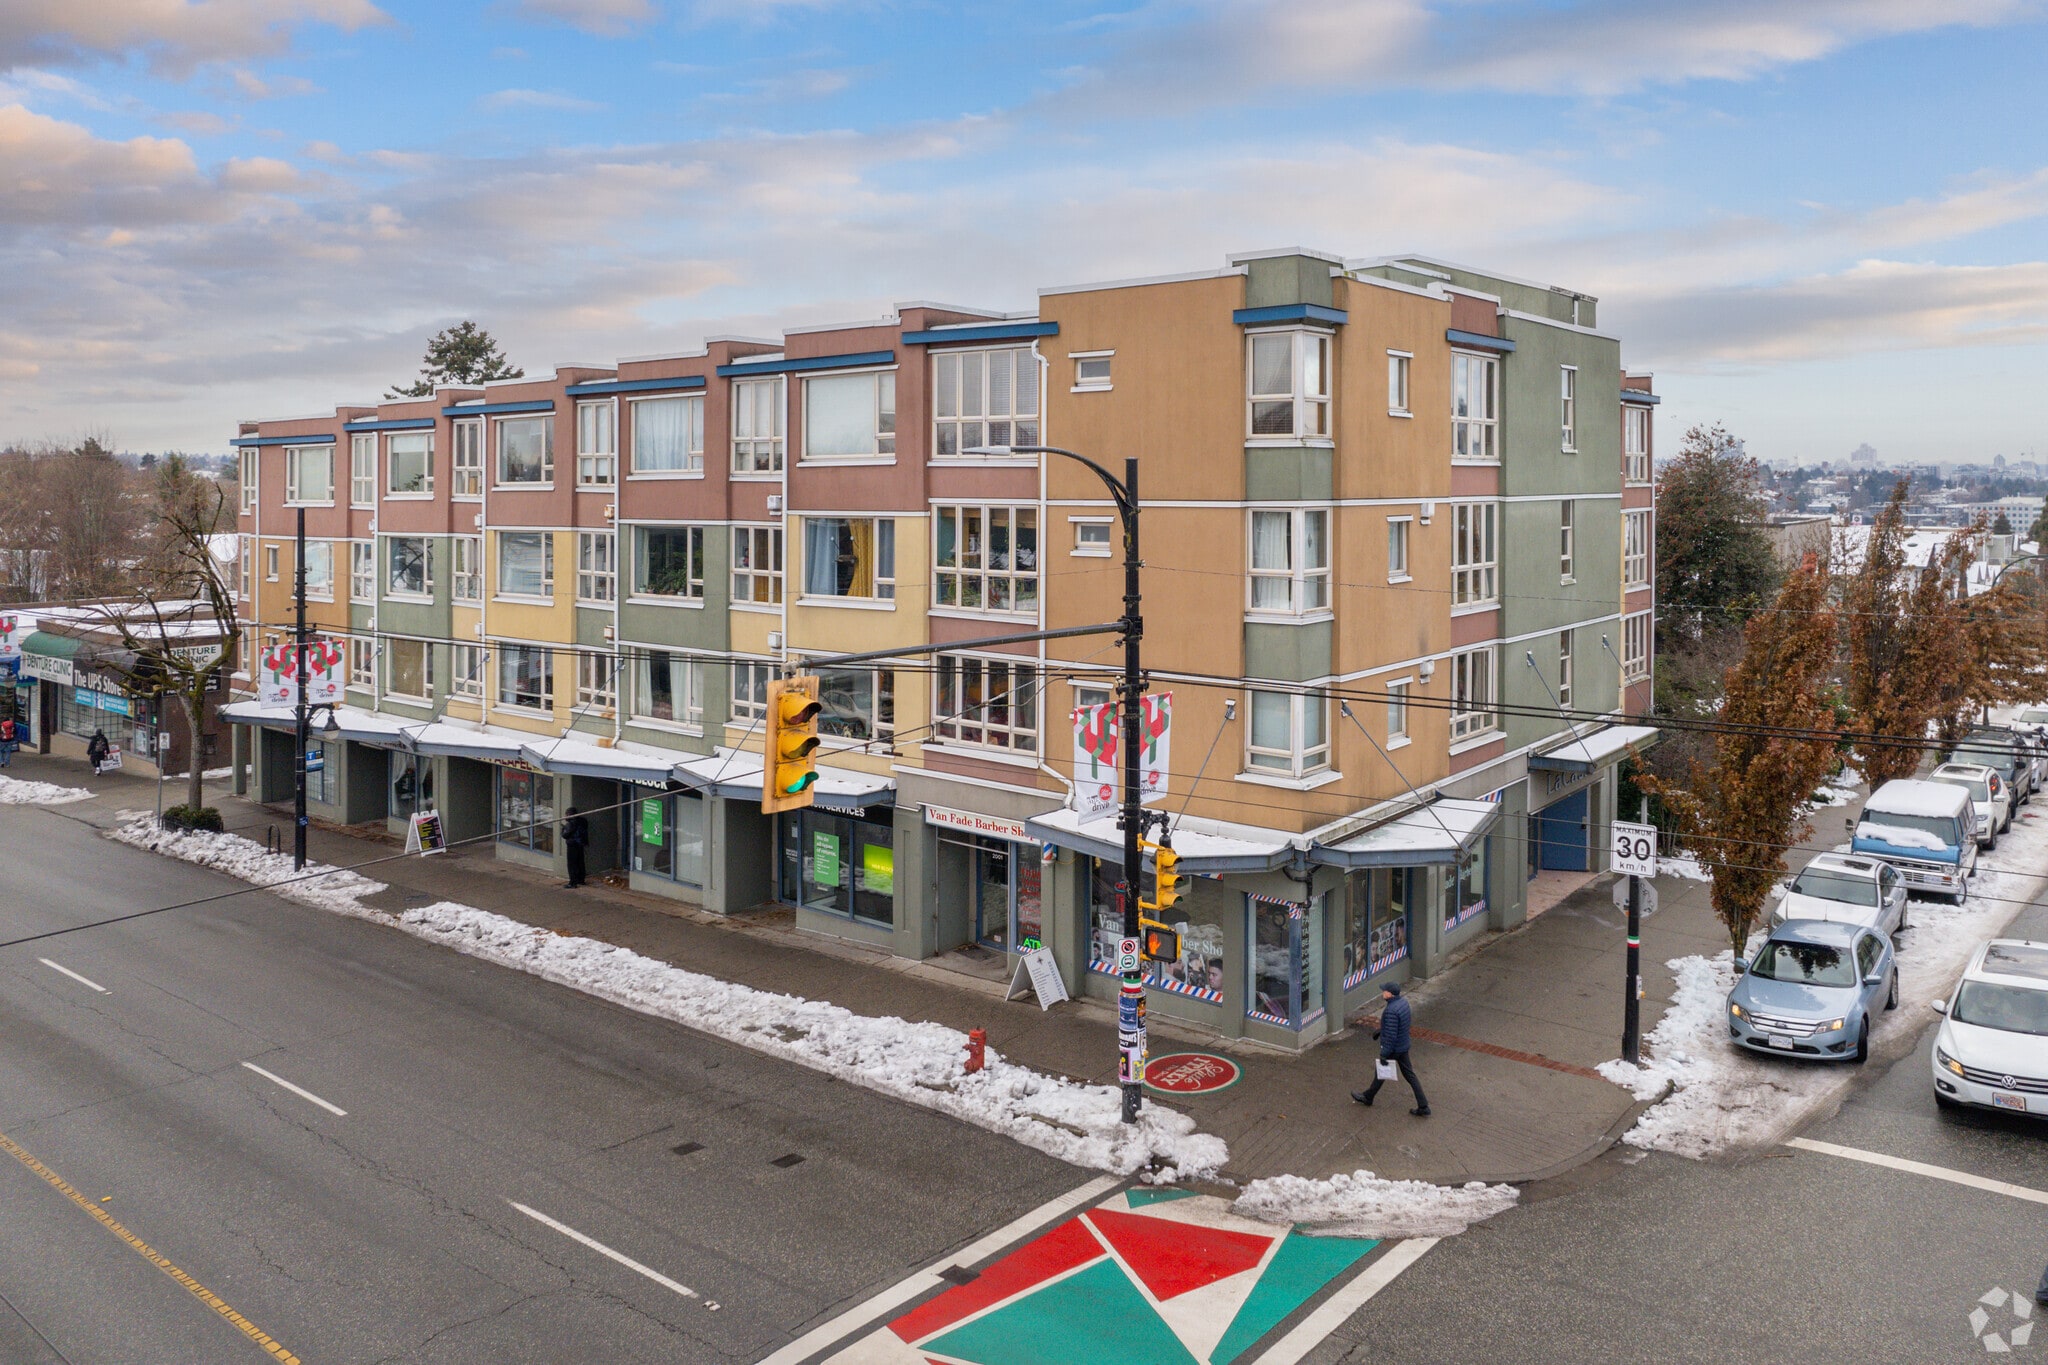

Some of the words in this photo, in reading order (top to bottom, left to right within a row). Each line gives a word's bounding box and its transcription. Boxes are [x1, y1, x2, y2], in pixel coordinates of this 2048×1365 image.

[170, 646, 216, 657] DENTURE
[27, 654, 52, 672] DENTURE
[53, 660, 71, 676] CLINIC
[74, 669, 87, 687] The
[87, 672, 102, 691] UPS
[103, 676, 122, 696] Store
[489, 757, 532, 771] ALAFEL
[929, 808, 947, 821] Van
[950, 813, 973, 827] Fade
[975, 818, 1008, 834] Barber
[1011, 825, 1034, 842] Sh
[1616, 827, 1652, 837] MAXIMUM
[1616, 836, 1651, 861] 30
[1619, 861, 1647, 872] km/h
[1098, 913, 1119, 932] Van
[1182, 938, 1200, 951] ber
[1202, 939, 1223, 957] Sho
[1160, 1057, 1211, 1086] ITALY
[1184, 1063, 1224, 1090] Little
